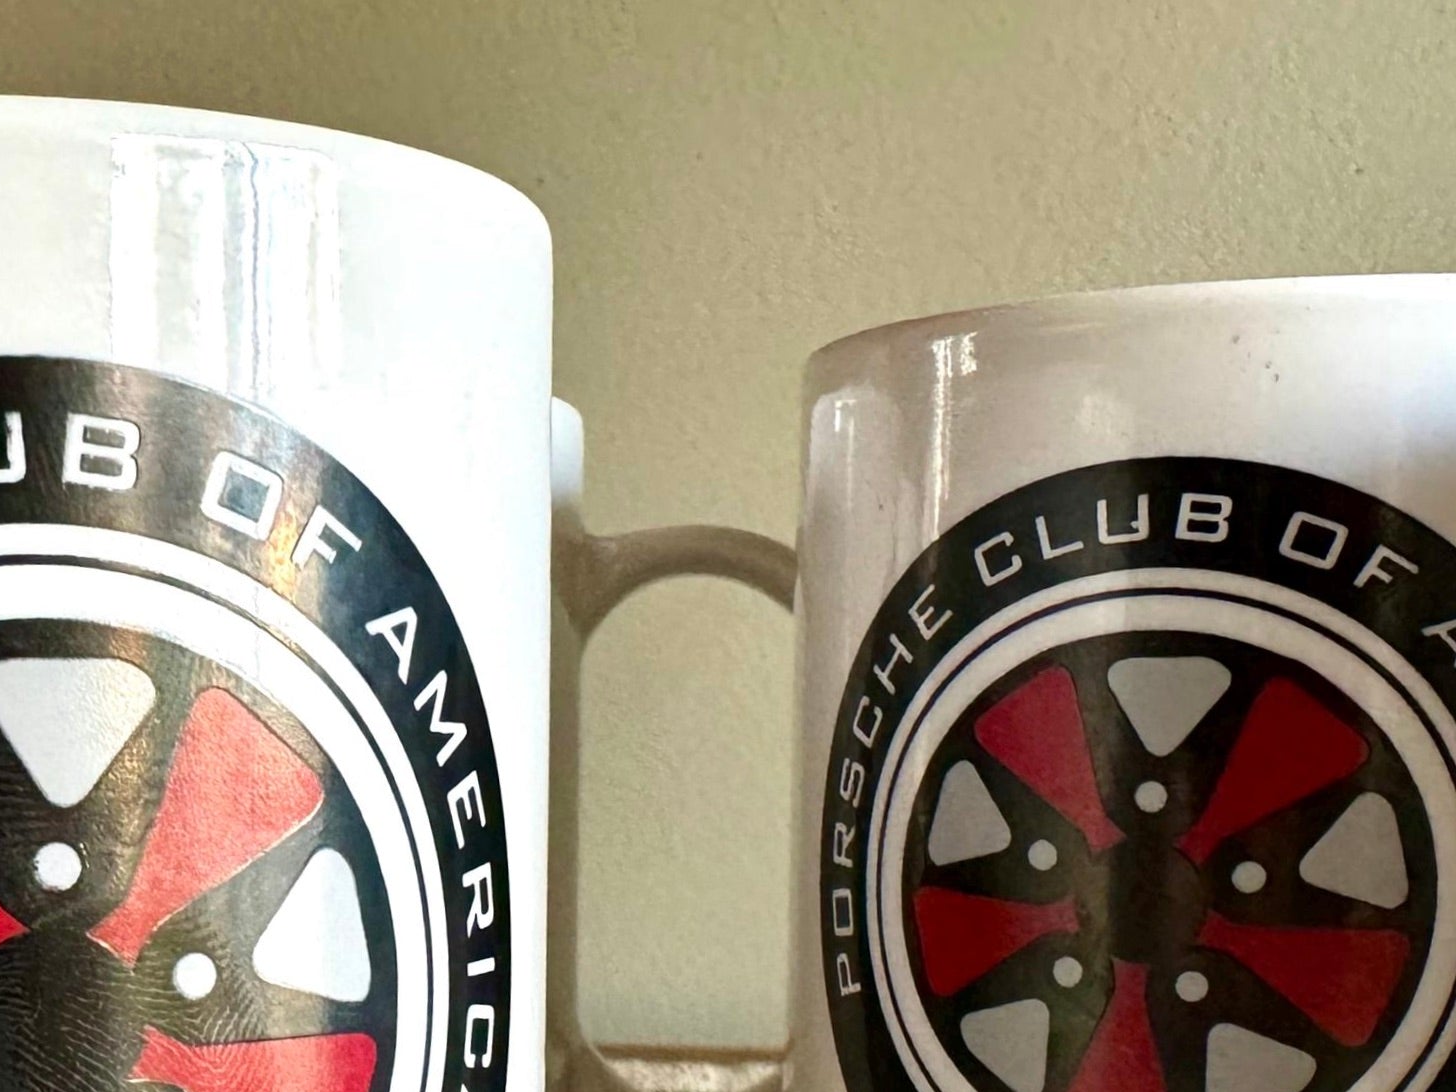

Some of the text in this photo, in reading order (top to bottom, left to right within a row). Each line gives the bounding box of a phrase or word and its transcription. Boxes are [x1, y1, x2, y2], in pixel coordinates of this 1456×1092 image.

[203, 451, 361, 566] OF
[831, 585, 951, 996] PORSCHE
[975, 493, 1232, 586] CLUB
[1280, 511, 1418, 587] OF
